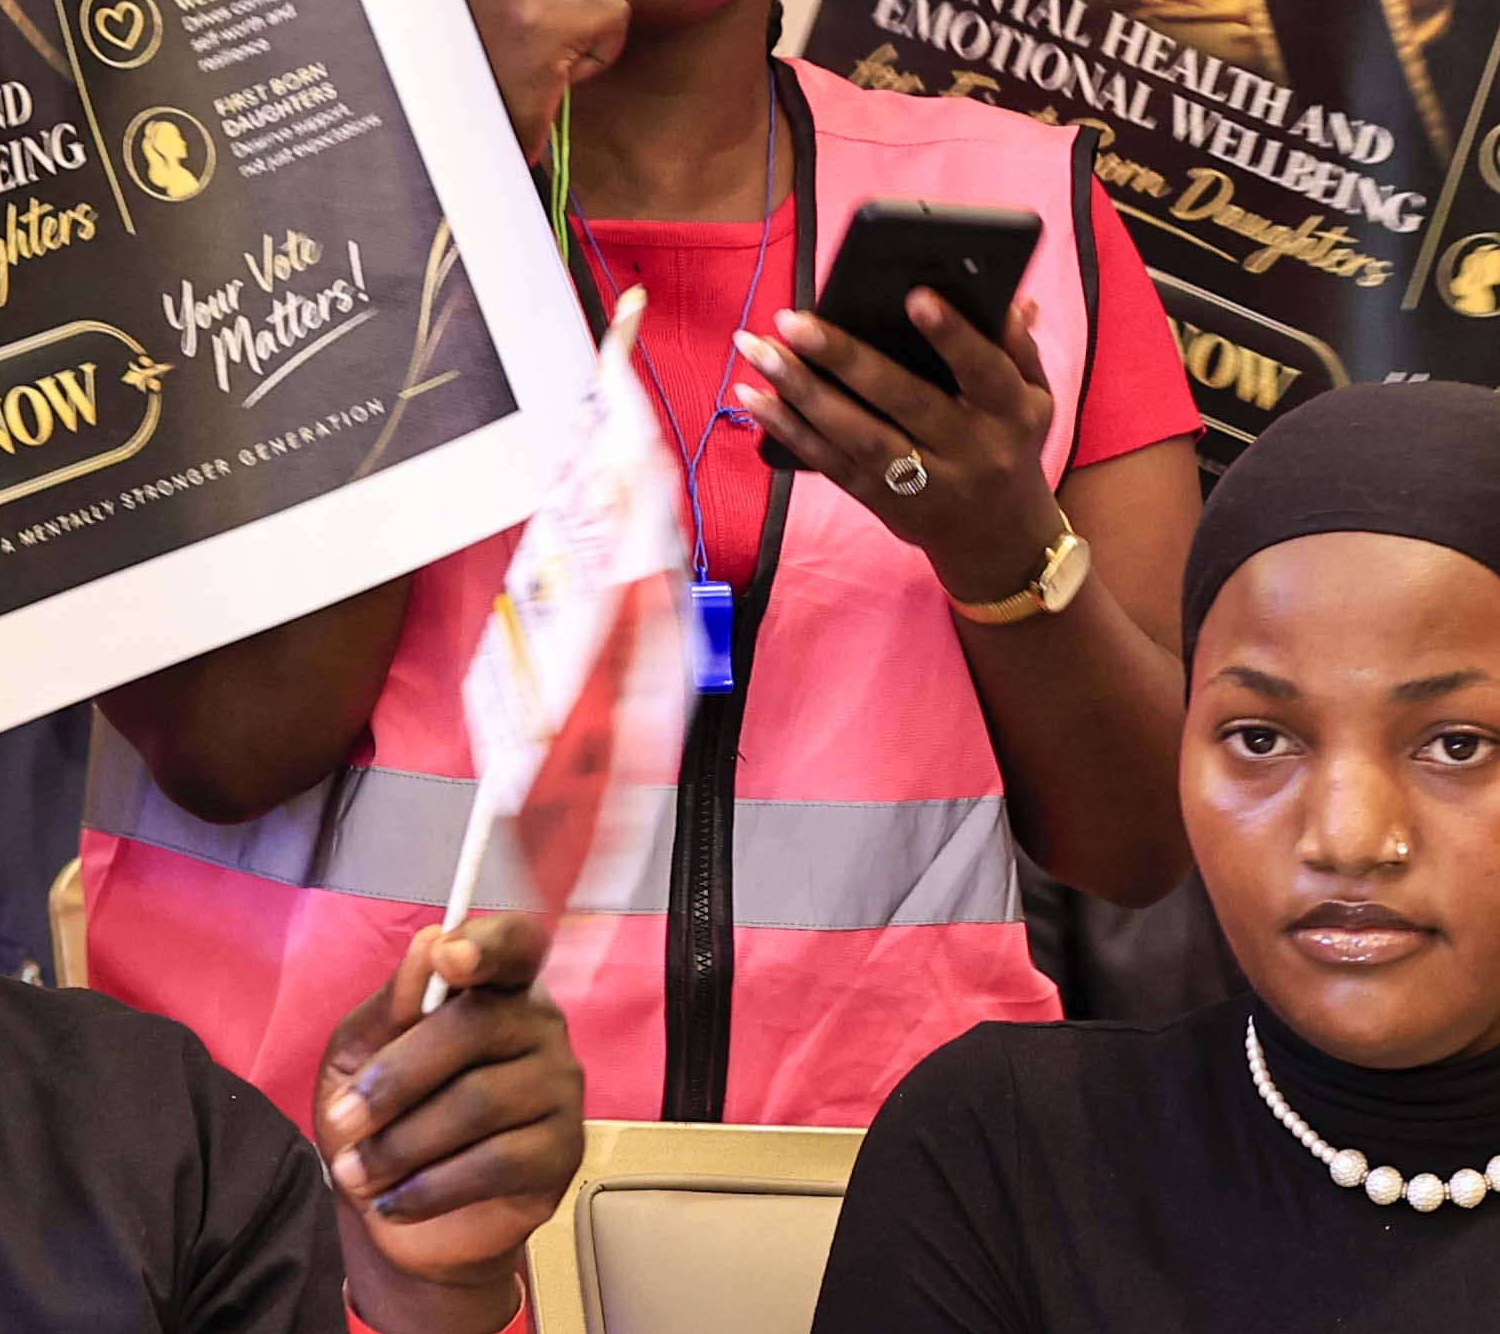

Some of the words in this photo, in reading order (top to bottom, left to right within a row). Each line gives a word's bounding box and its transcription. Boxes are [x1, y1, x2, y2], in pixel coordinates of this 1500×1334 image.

[1100, 9, 1293, 130] HEALTH
[1295, 102, 1396, 165] AND
[1171, 91, 1428, 235] WELLBEING
[1174, 167, 1396, 288] Daughters
[162, 275, 245, 358] Your
[244, 229, 323, 294] Vote
[211, 239, 371, 395] Matters!
[1, 536, 13, 555] A
[18, 499, 117, 549] MENTALLY
[119, 456, 233, 513] STRONGER
[238, 397, 387, 469] GENERATION
